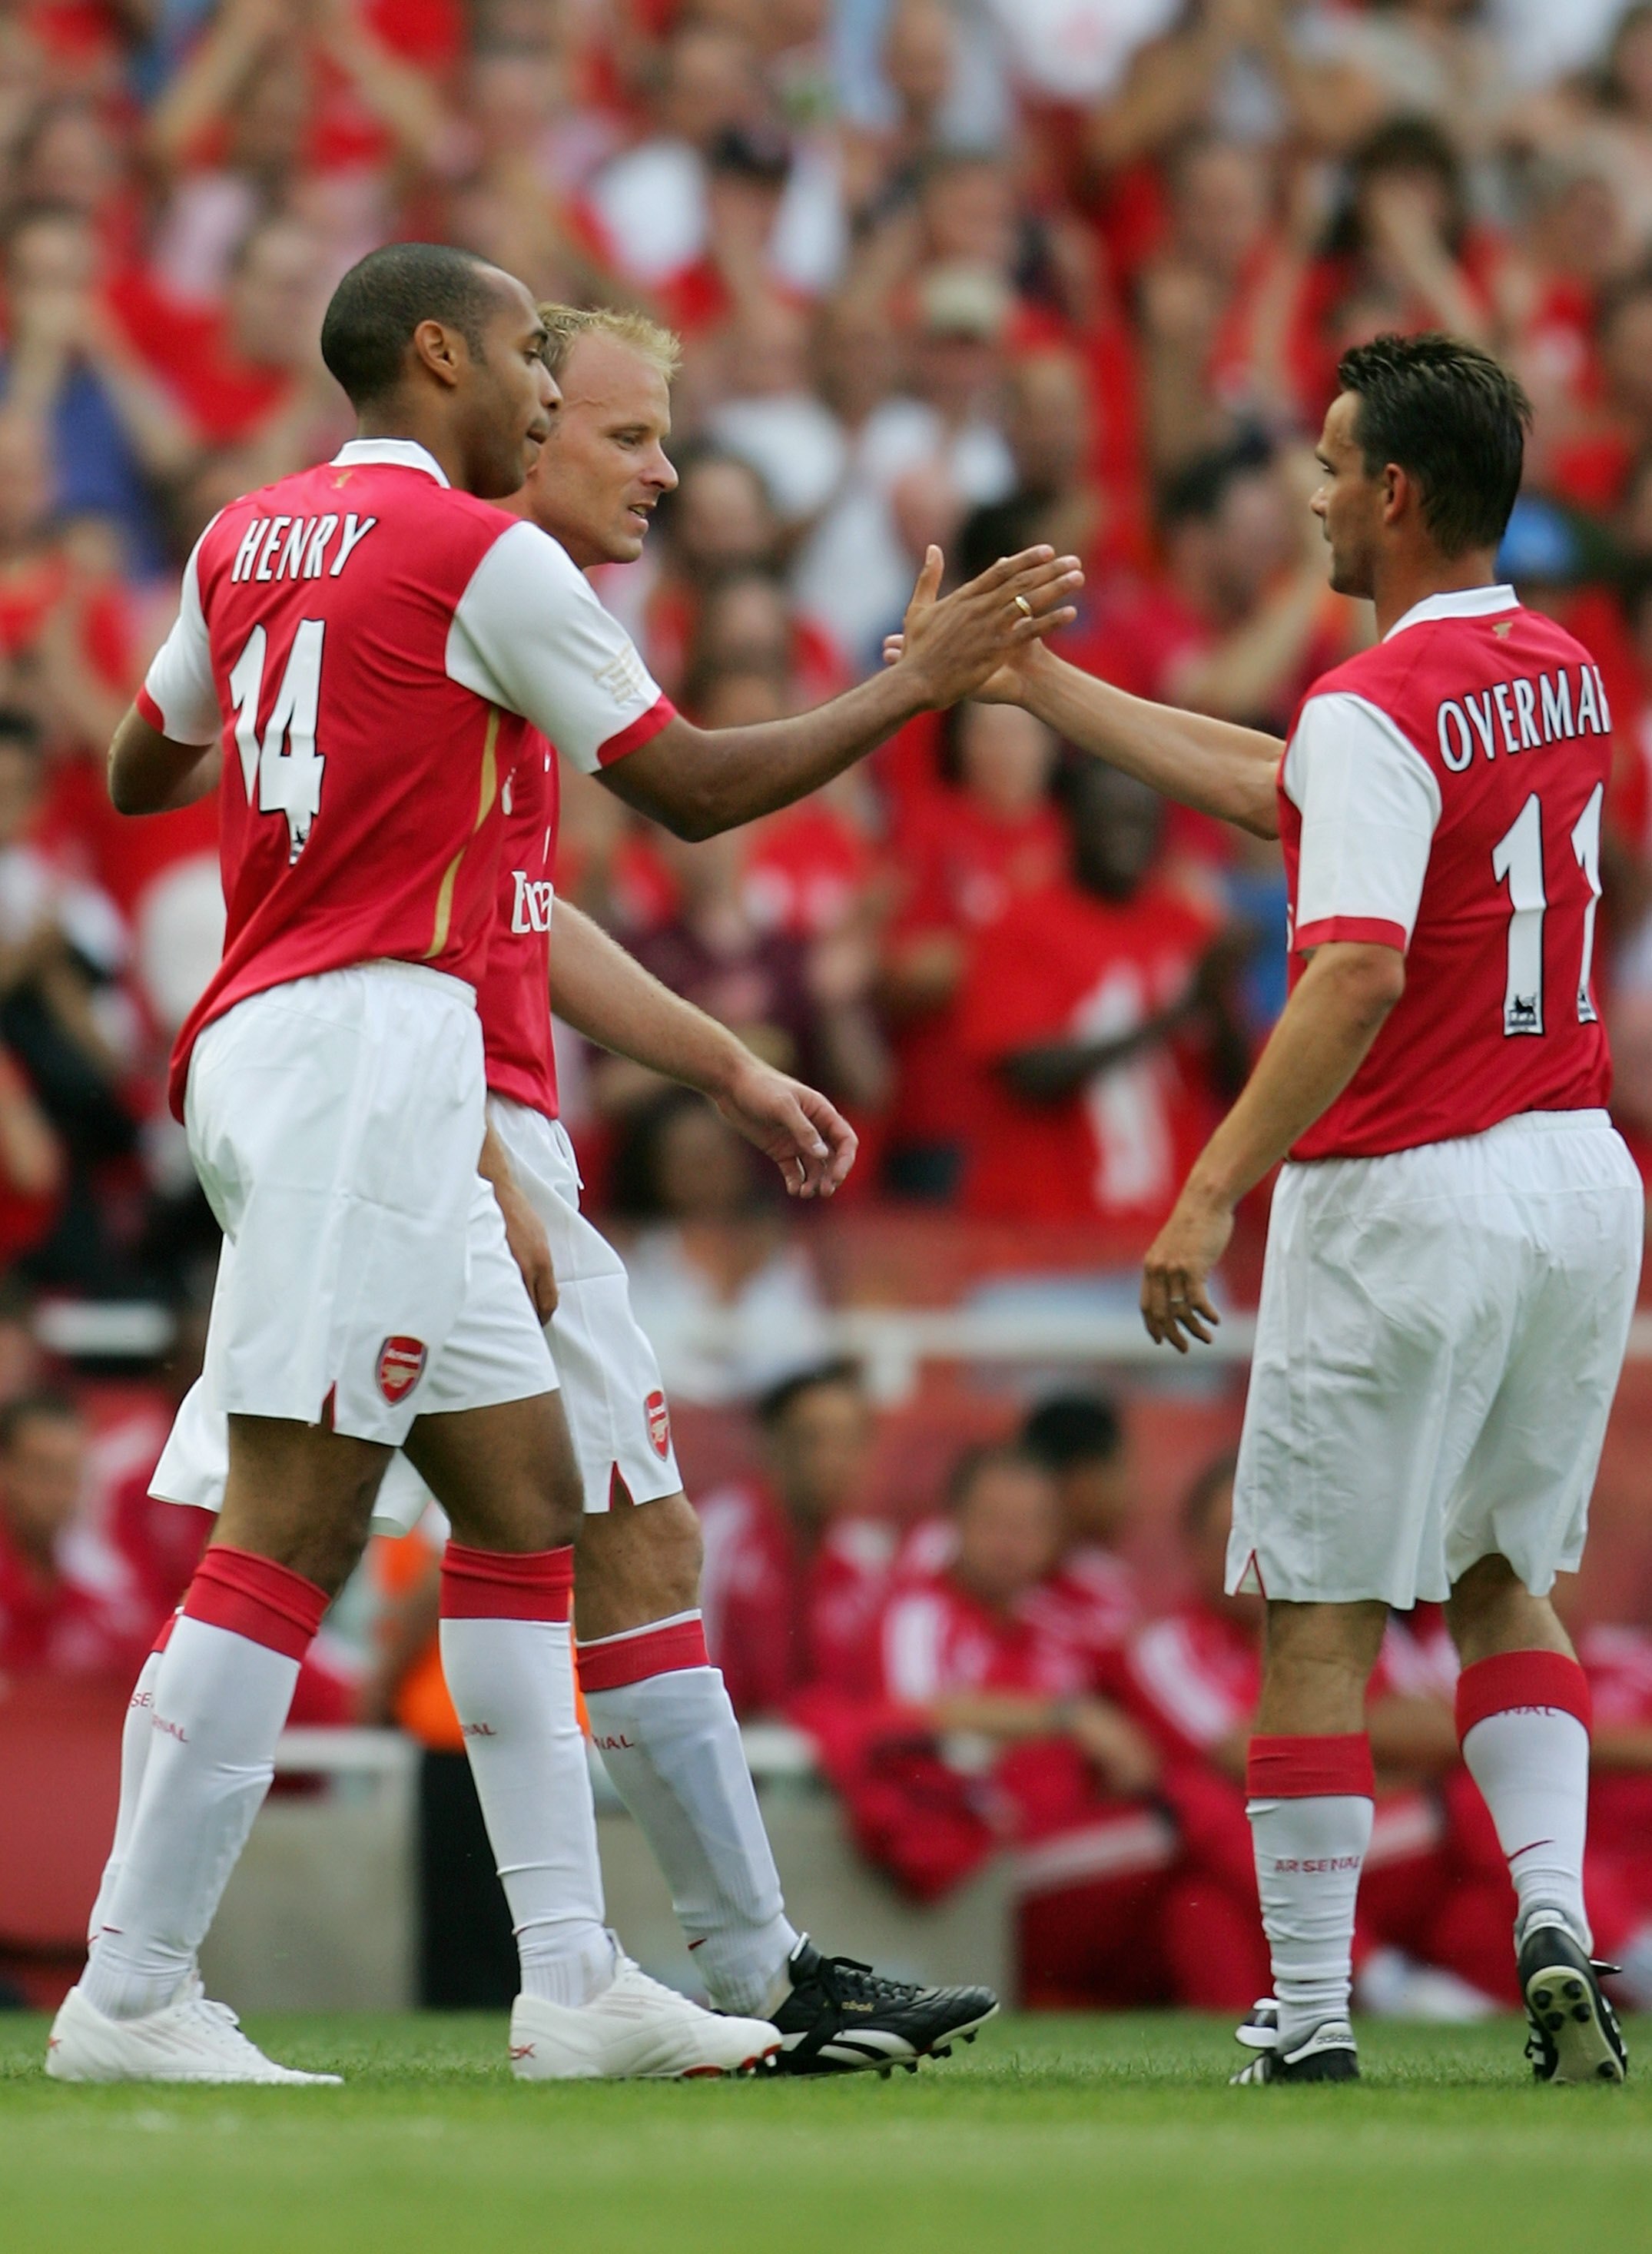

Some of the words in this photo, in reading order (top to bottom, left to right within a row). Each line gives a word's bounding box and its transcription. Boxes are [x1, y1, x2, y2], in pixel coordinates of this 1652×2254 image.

[232, 513, 377, 583] HENRY
[229, 619, 326, 865] 14
[1491, 782, 1603, 1037] 11
[1275, 1856, 1360, 1873] ARSENAL
